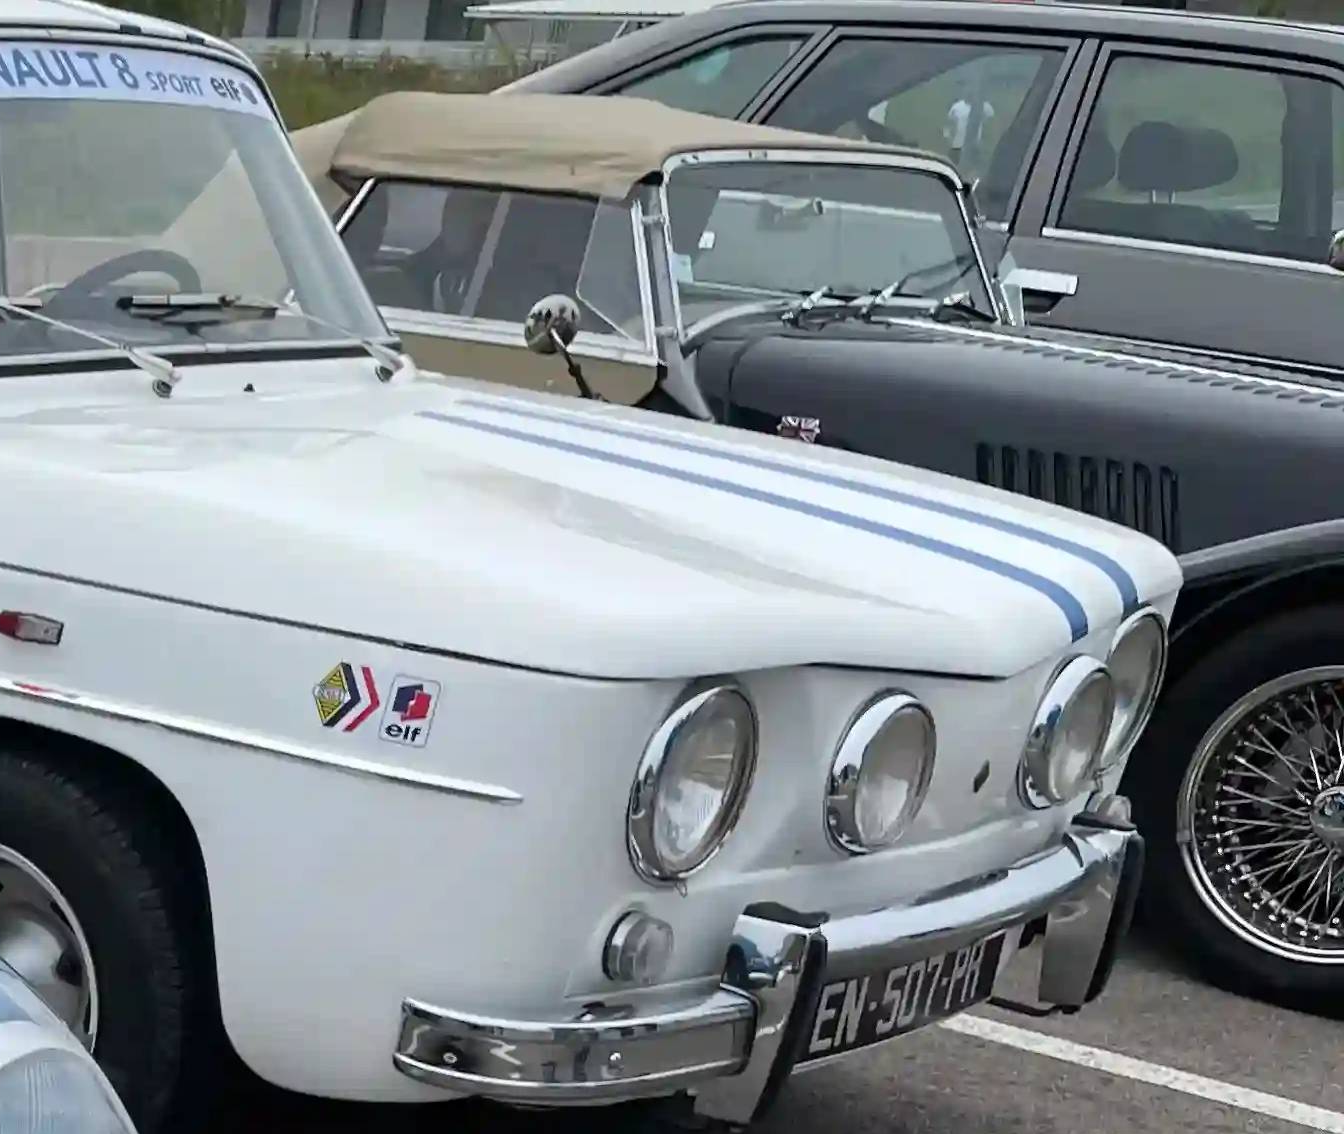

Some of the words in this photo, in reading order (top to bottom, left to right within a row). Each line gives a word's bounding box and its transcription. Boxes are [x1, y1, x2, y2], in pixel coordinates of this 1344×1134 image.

[109, 53, 139, 90] 8
[144, 71, 204, 97] SPORT
[210, 77, 242, 102] elf
[385, 724, 422, 742] elf
